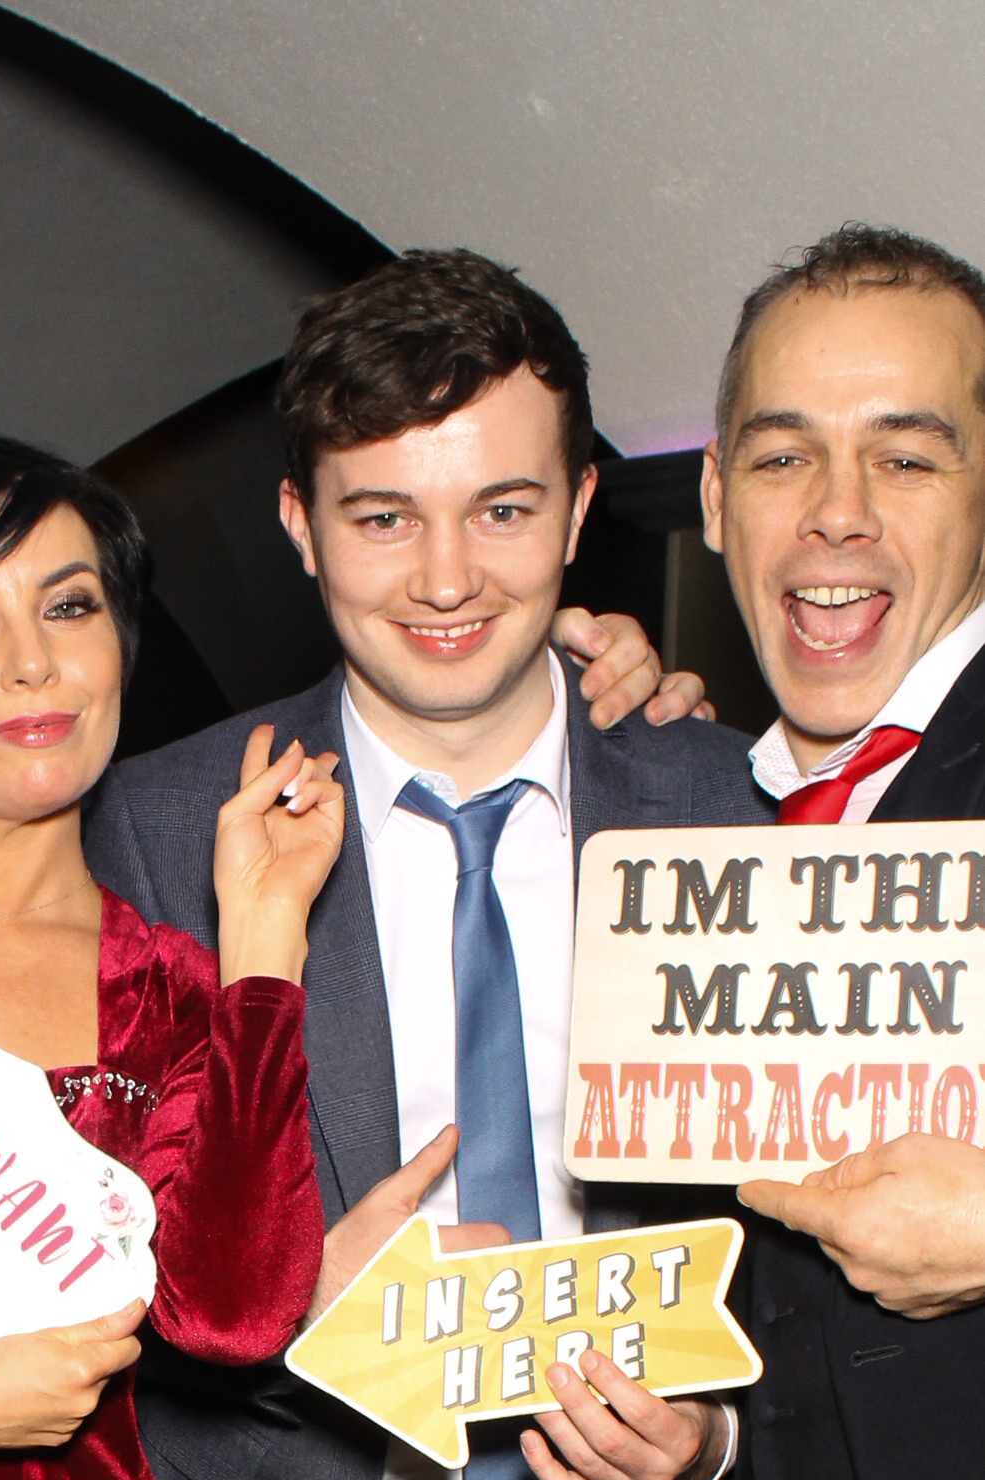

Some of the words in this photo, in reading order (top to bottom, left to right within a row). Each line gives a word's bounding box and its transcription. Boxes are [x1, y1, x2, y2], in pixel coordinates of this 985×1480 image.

[610, 857, 763, 935] IM
[652, 961, 968, 1036] MAIN
[573, 1063, 985, 1162] ATTRACTIO
[381, 1245, 690, 1345] INSERT
